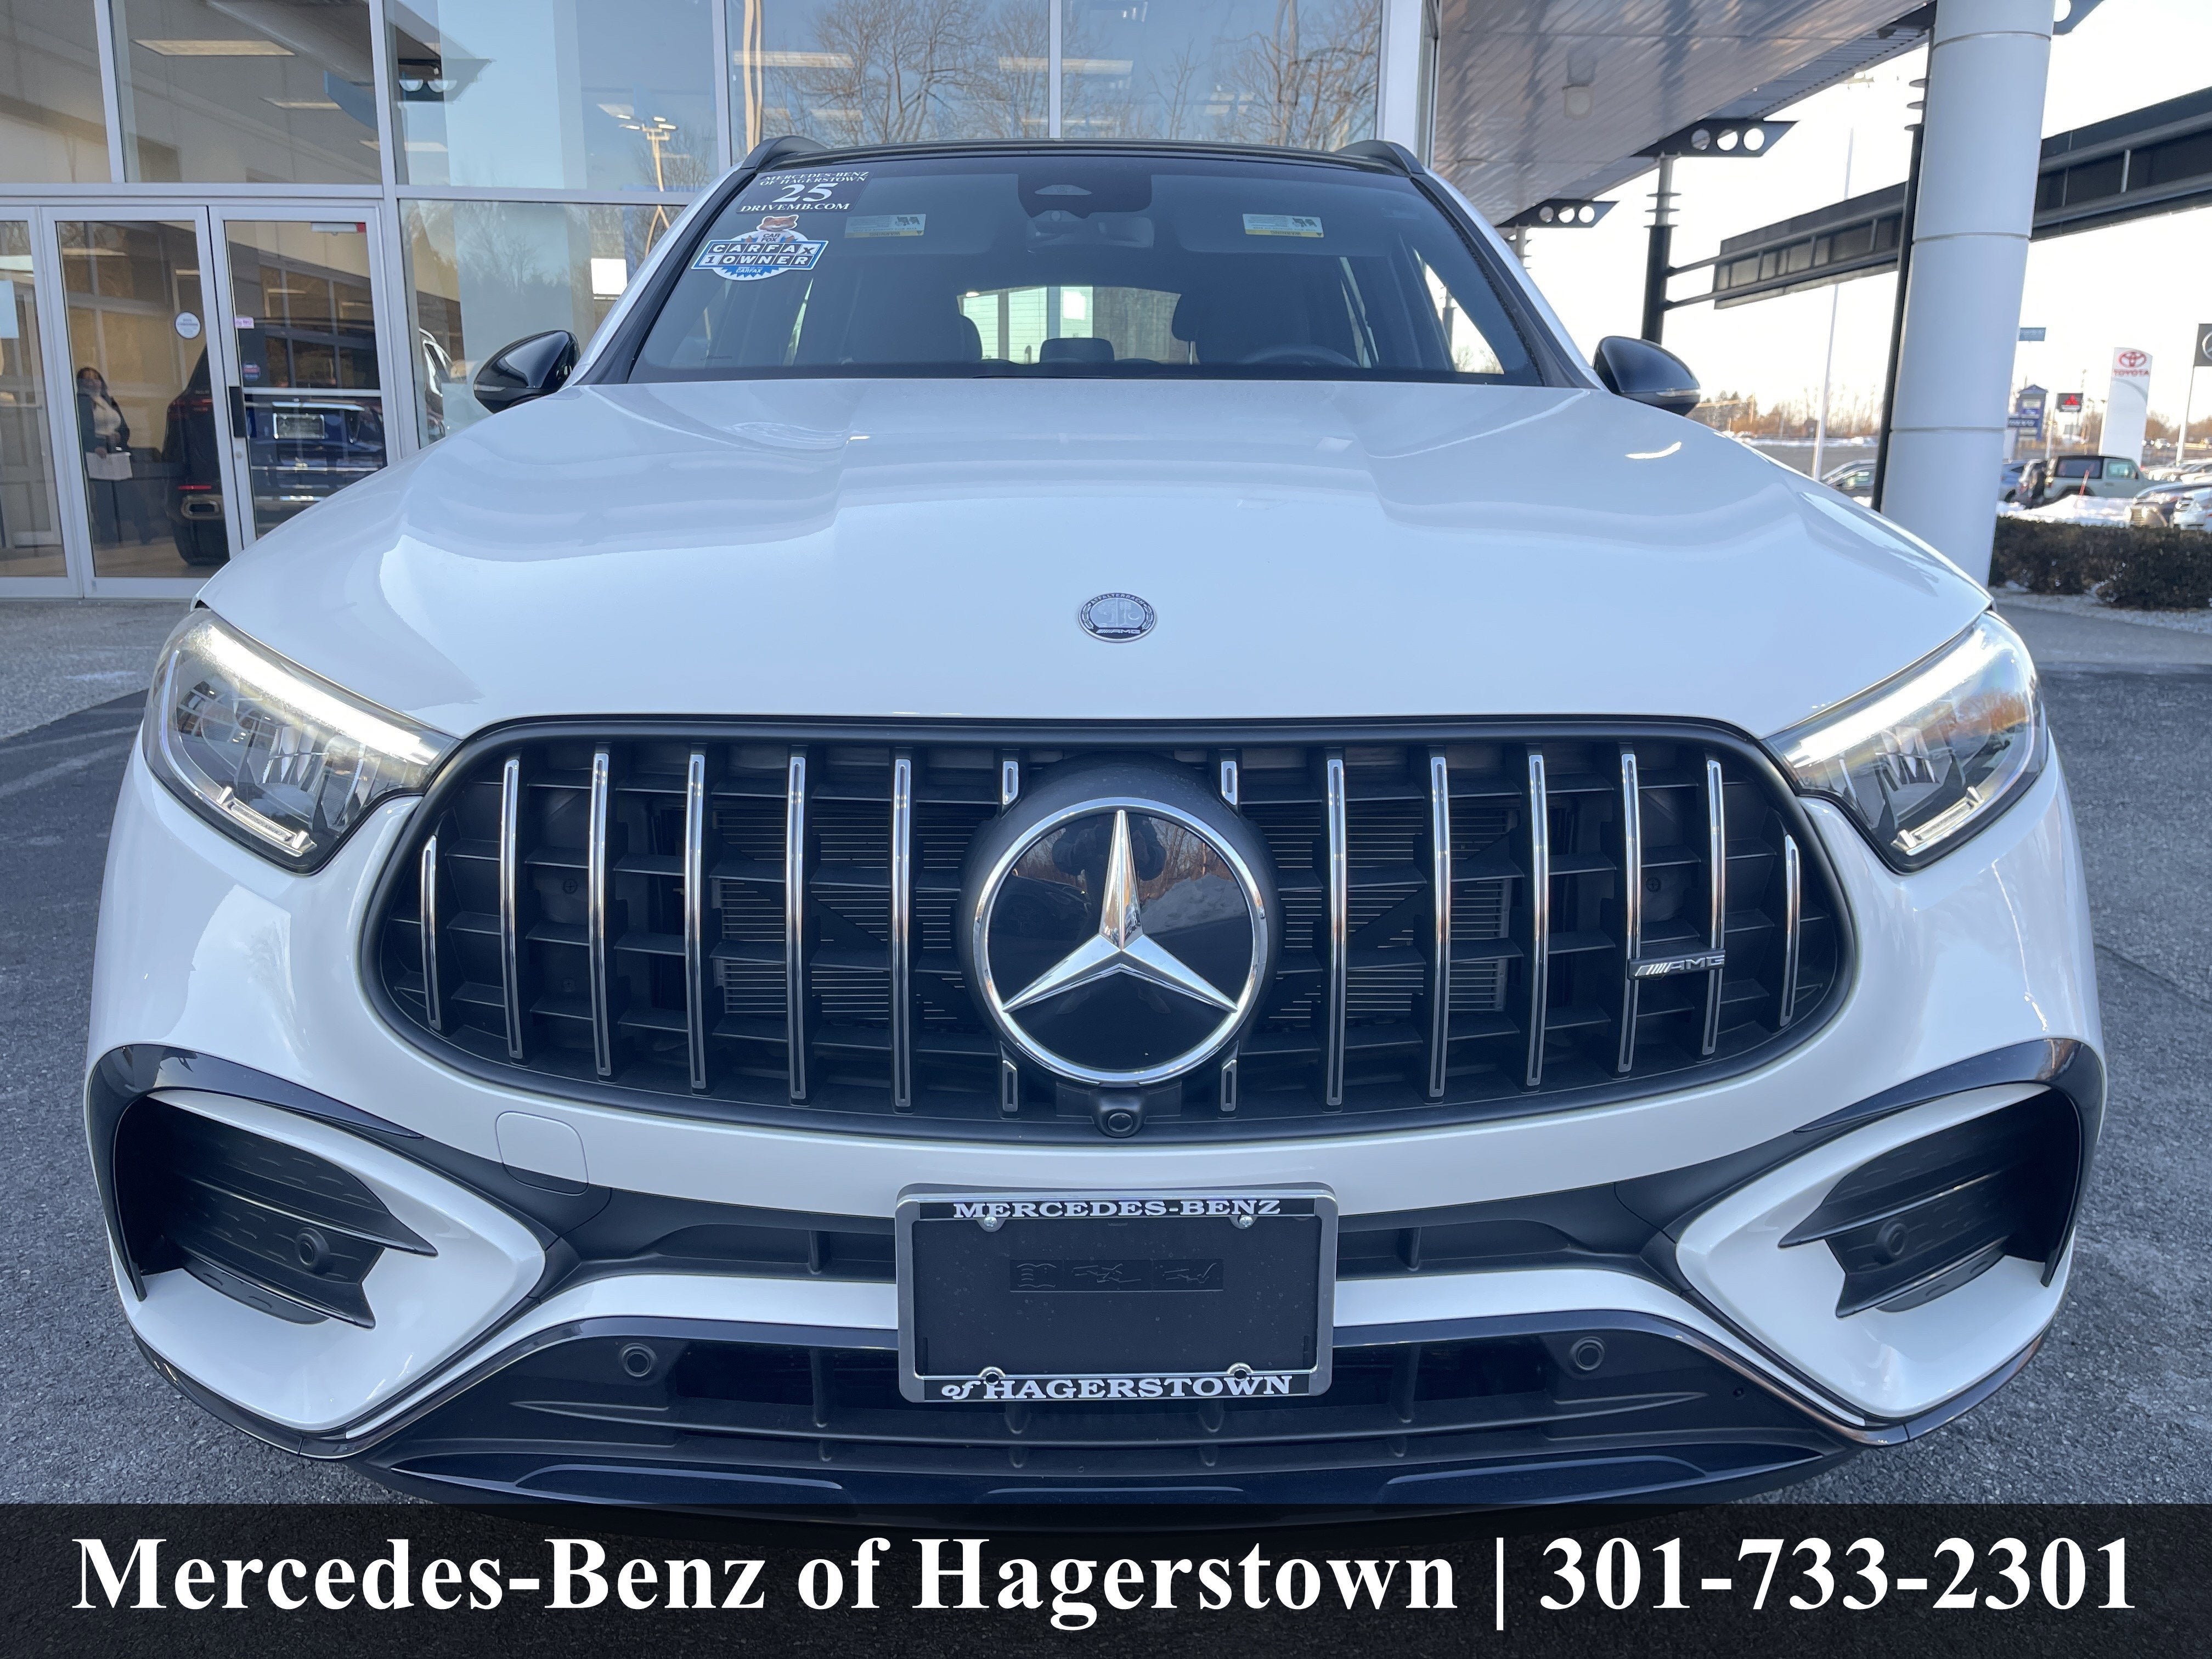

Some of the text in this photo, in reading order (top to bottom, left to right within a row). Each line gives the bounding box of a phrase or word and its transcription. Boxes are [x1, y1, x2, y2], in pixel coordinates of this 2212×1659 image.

[764, 171, 870, 181] MERCEDES-BENZ
[780, 176, 867, 184] HAGERSTOWN
[772, 183, 838, 203] 25
[741, 203, 850, 212] DRIVEMB.COM
[713, 244, 816, 255] CARFAX
[704, 255, 809, 264] 1 OWNER
[2113, 369, 2149, 377] TOYOTA
[952, 1199, 1281, 1219] MERCEDES-BENZ
[941, 1375, 1293, 1400] of HAGERSTOWN
